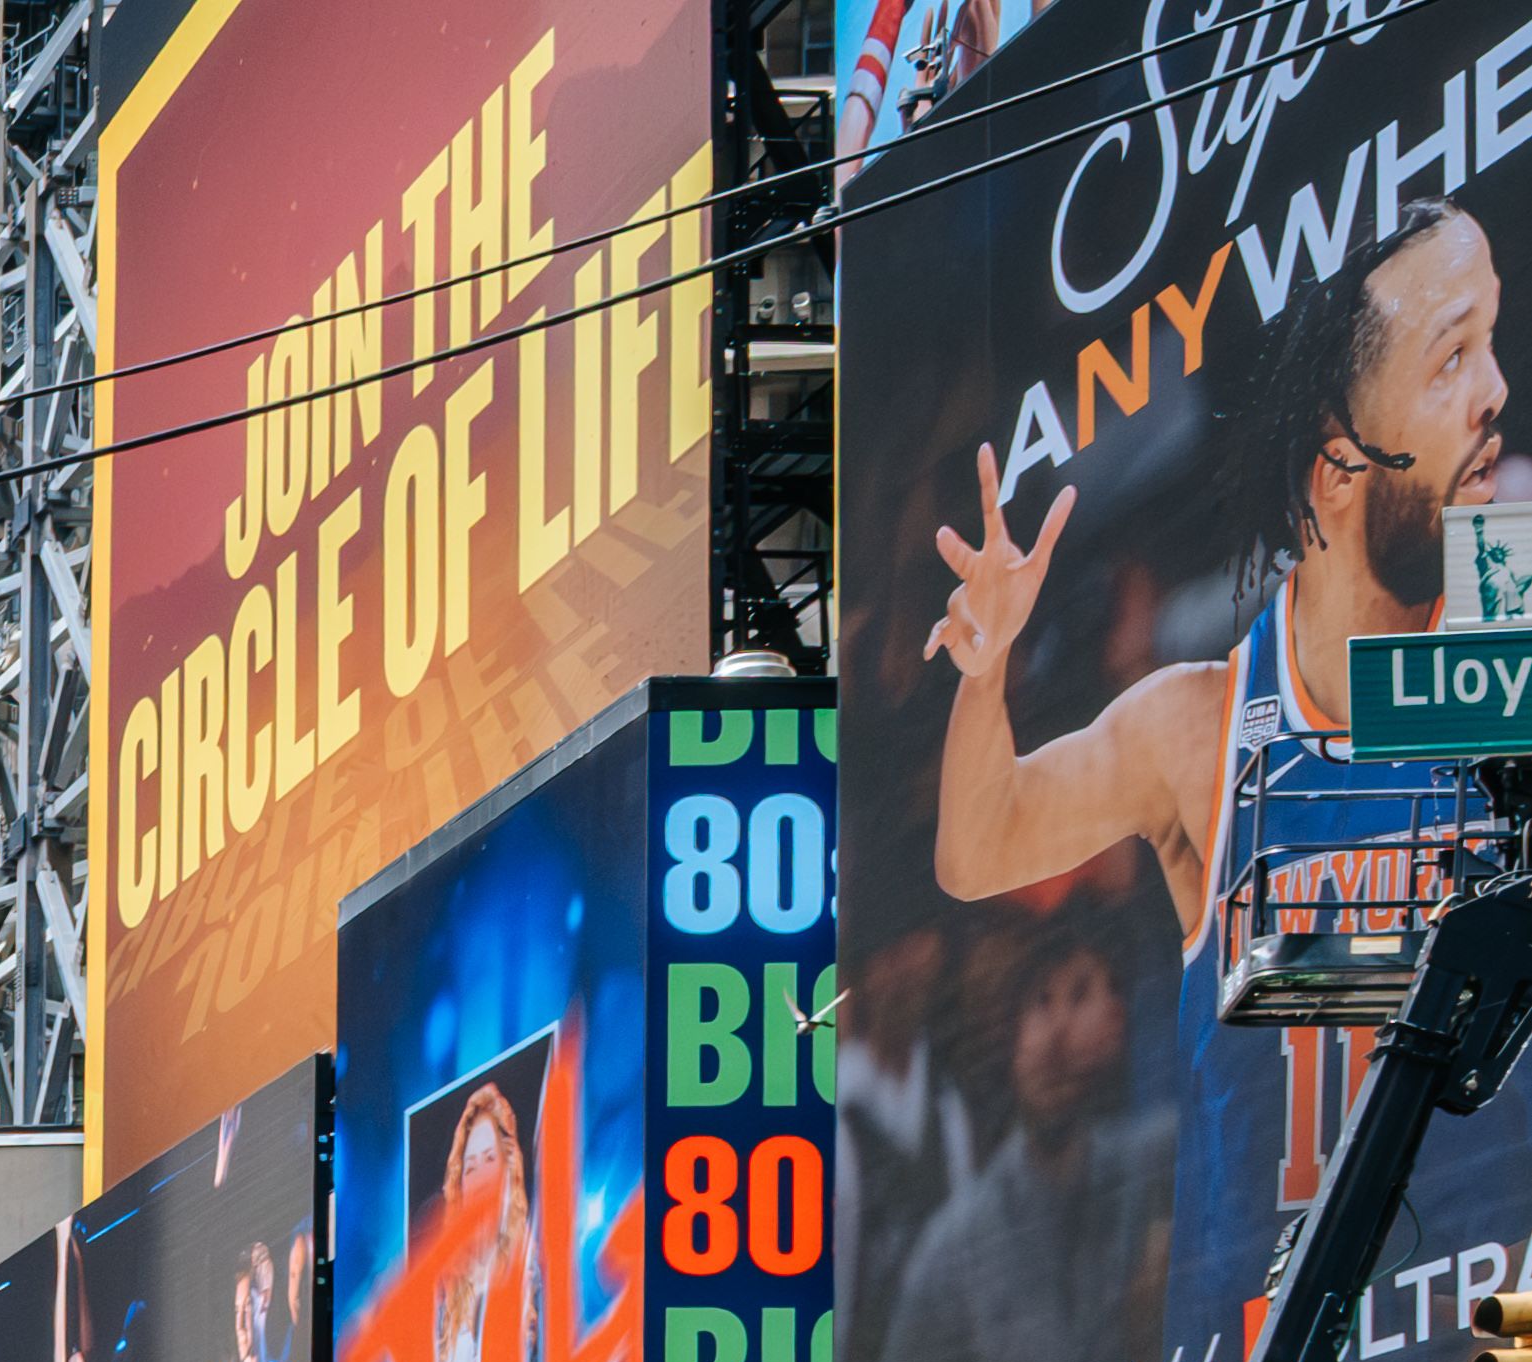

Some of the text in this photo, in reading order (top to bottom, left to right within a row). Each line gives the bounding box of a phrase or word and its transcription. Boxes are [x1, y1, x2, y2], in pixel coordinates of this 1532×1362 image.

[118, 139, 713, 930] CIRCLE OF LIFE
[224, 27, 555, 580] JOIN THE
